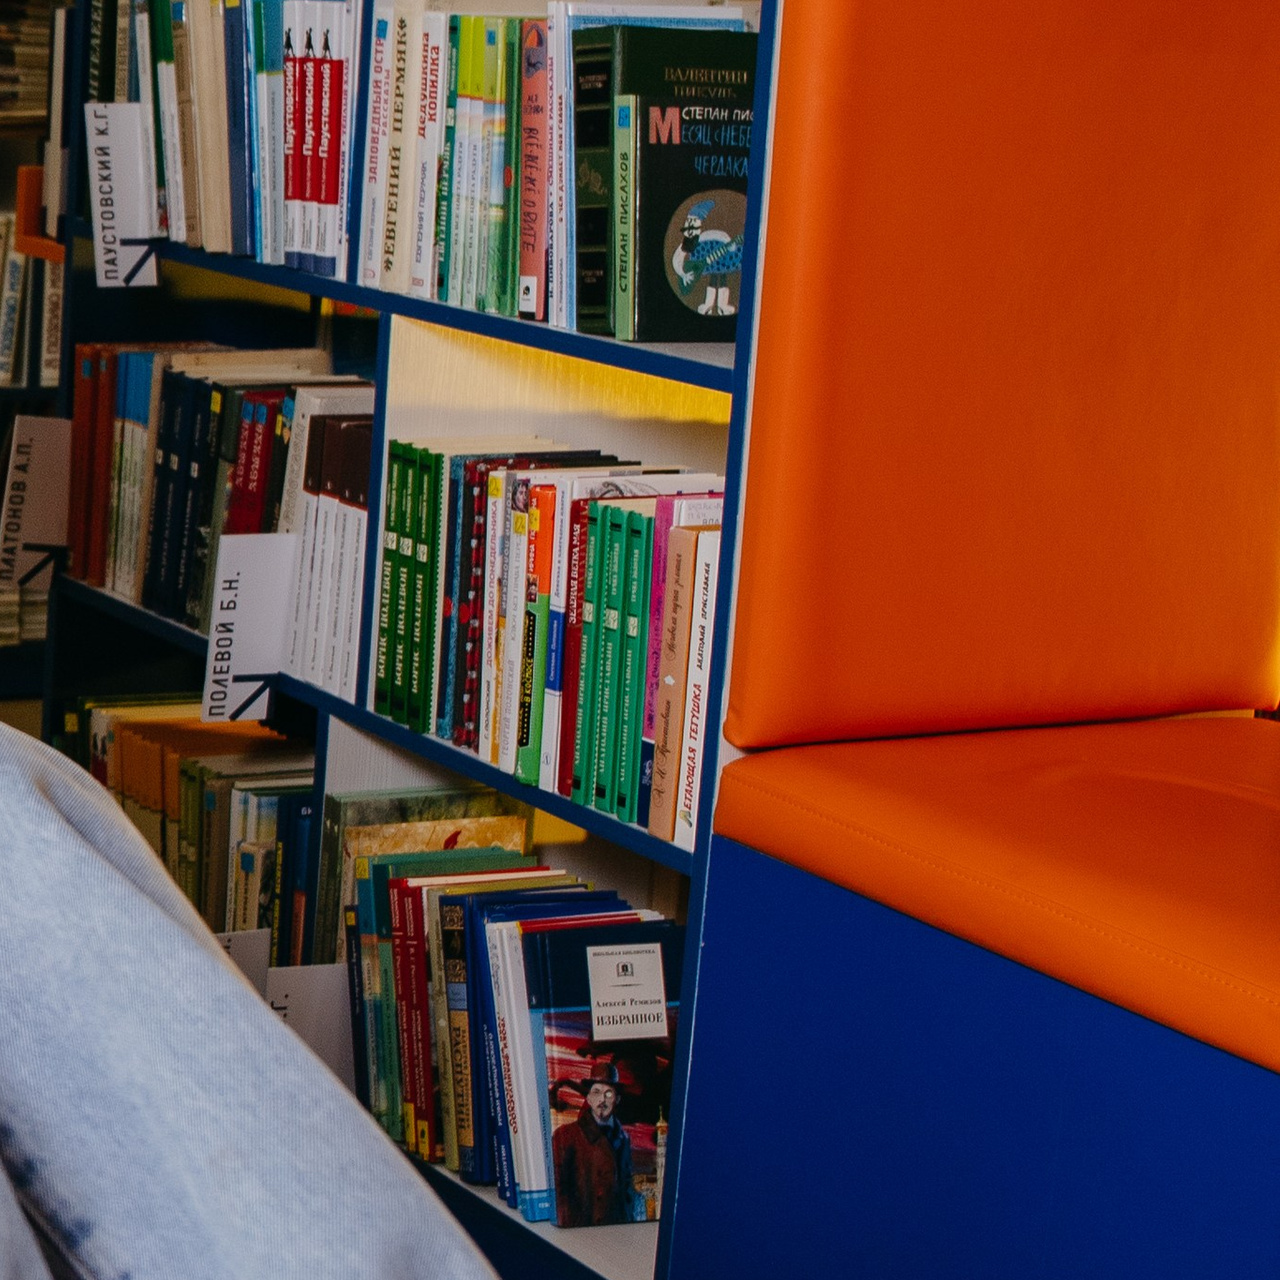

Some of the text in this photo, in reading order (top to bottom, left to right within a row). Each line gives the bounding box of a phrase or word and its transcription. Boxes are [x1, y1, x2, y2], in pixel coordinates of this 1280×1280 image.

[284, 61, 296, 155] Паустовский
[303, 61, 315, 156] Паустовский
[319, 63, 331, 158] Паустовский
[382, 68, 390, 136] РАССКАЗЫ
[664, 66, 748, 85] ВАЛЕНТИН
[682, 106, 728, 121] СТЕПАН
[368, 79, 382, 184] ЗАПОВЕДНЫЙ
[694, 155, 749, 178] ЧЕРДАКА
[92, 103, 119, 281] ПАУСТОВСКИЙ К.Г.
[415, 161, 428, 263] ЕВГЕНИЙ ПЕРМЯК
[619, 152, 629, 293] СТЕПАН ПИСАХОВ
[14, 437, 34, 475] А.П.
[488, 500, 499, 589] ПОНЕДЕЛЬНИКА
[571, 547, 579, 578] ВЕТКА
[572, 523, 581, 545] МАЯ
[377, 561, 392, 678] БОРИС ПОЛЕВОЙ
[395, 567, 408, 685] БОРИС ПОЛЕВОЙ
[413, 573, 424, 642] ПОЛЕВОЙ
[487, 591, 495, 606] ДО
[208, 571, 240, 717] ПОЛЕВОЙ Б.Н.
[687, 562, 710, 742] ТЕТУШКА АНАТОЛИЙ ПРИСТАВКИН
[596, 998, 662, 1008] Алексей Ремизов
[596, 1012, 664, 1027] ИЗБРАННОЕ
